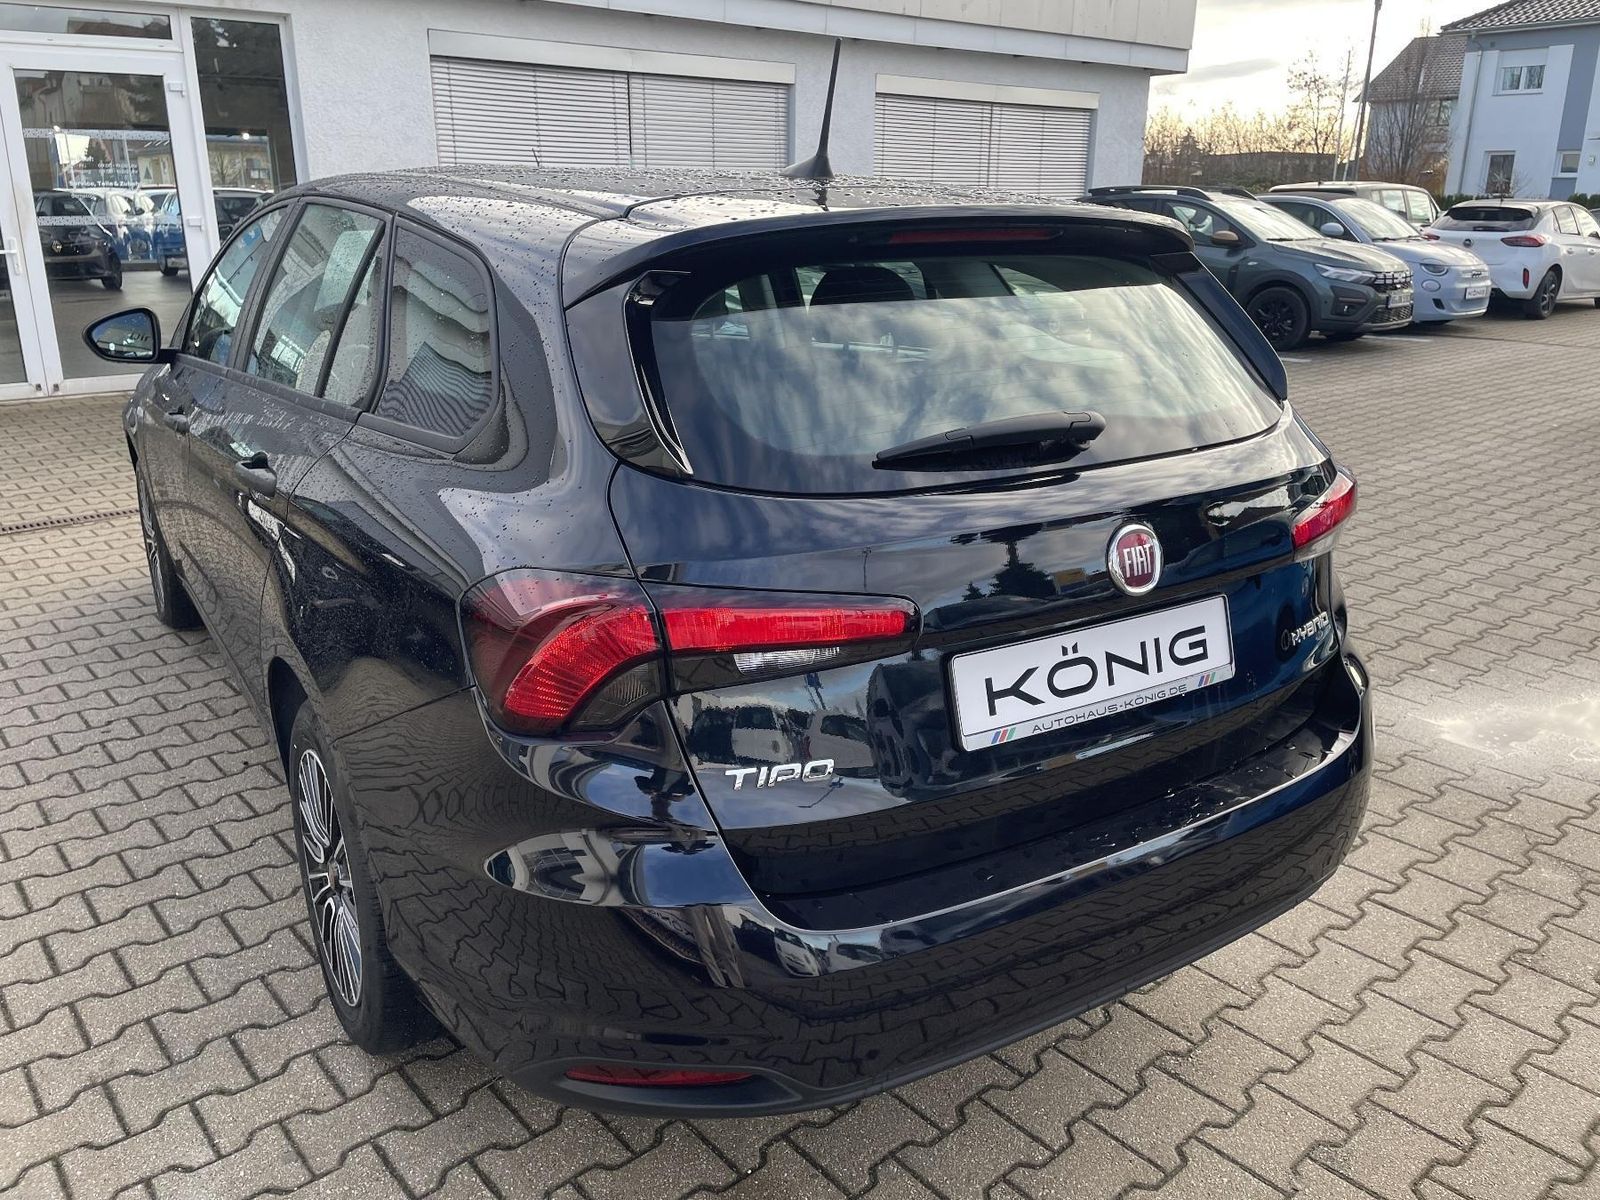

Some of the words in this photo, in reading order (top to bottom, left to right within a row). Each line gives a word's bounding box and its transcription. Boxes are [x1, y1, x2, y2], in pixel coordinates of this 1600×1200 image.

[1122, 544, 1153, 578] FIAT
[984, 625, 1209, 717] KÖNIG
[1031, 683, 1189, 734] AUTOHAUS-KÖNIG.DE
[724, 758, 835, 791] TIPO
